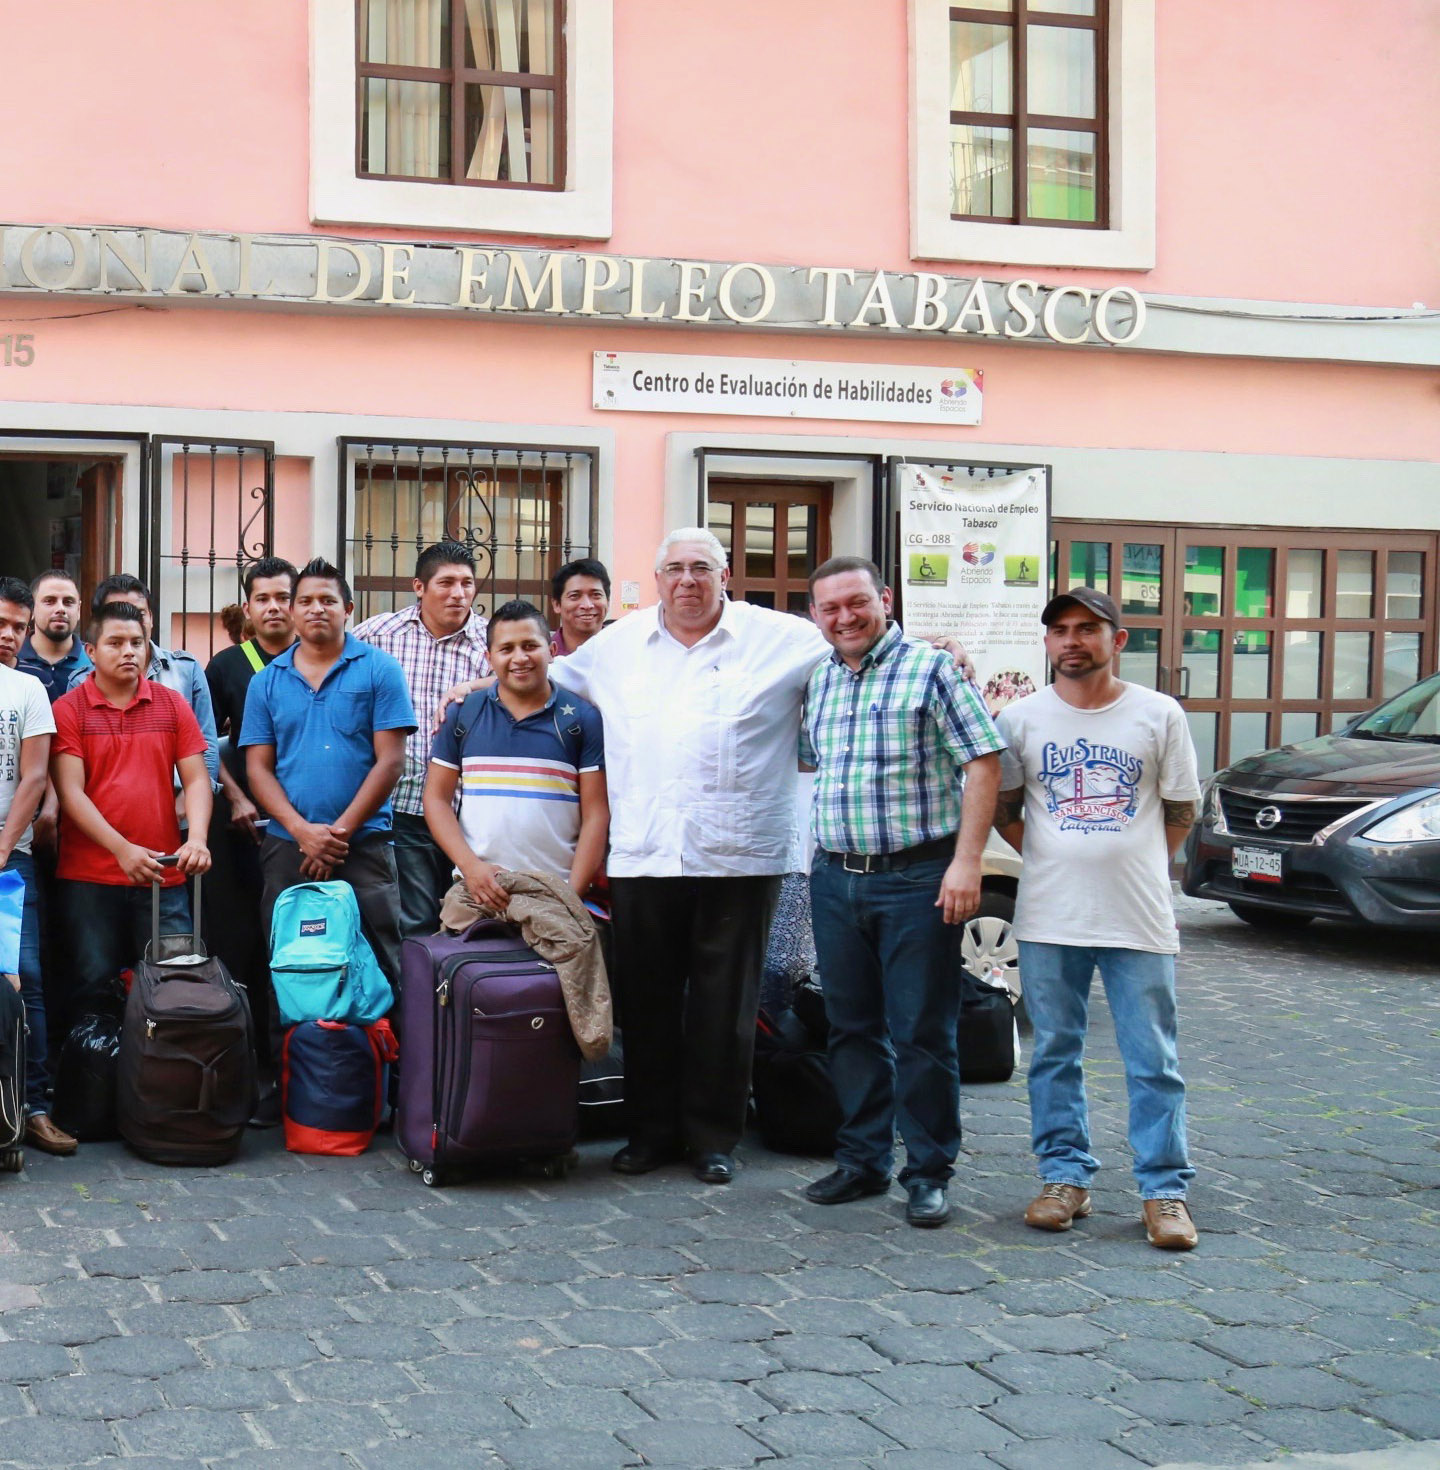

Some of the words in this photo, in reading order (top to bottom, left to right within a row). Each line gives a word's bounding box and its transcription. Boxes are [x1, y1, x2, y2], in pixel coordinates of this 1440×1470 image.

[310, 241, 416, 304] DE
[452, 246, 776, 324] EMPLEO
[806, 266, 1147, 344] TABASCO
[632, 369, 689, 394] Centro
[694, 372, 715, 395] de
[720, 373, 808, 399] Evaluación
[814, 376, 833, 400] de
[838, 379, 933, 405] Habilidades
[910, 500, 952, 512] Servicio
[954, 503, 995, 513] Nacional
[998, 504, 1008, 513] de
[1010, 504, 1038, 515] Empleo
[962, 518, 997, 528] Tabasco
[909, 534, 923, 544] CG
[932, 534, 951, 544] 088
[961, 567, 993, 576] Abriendo
[961, 576, 992, 585] Espacios
[1037, 742, 1075, 781] LEVI
[1073, 738, 1143, 786] STRAUSS
[1054, 807, 1073, 819] SAN
[1074, 804, 1128, 823] FRANCISCO
[1060, 818, 1121, 834] California
